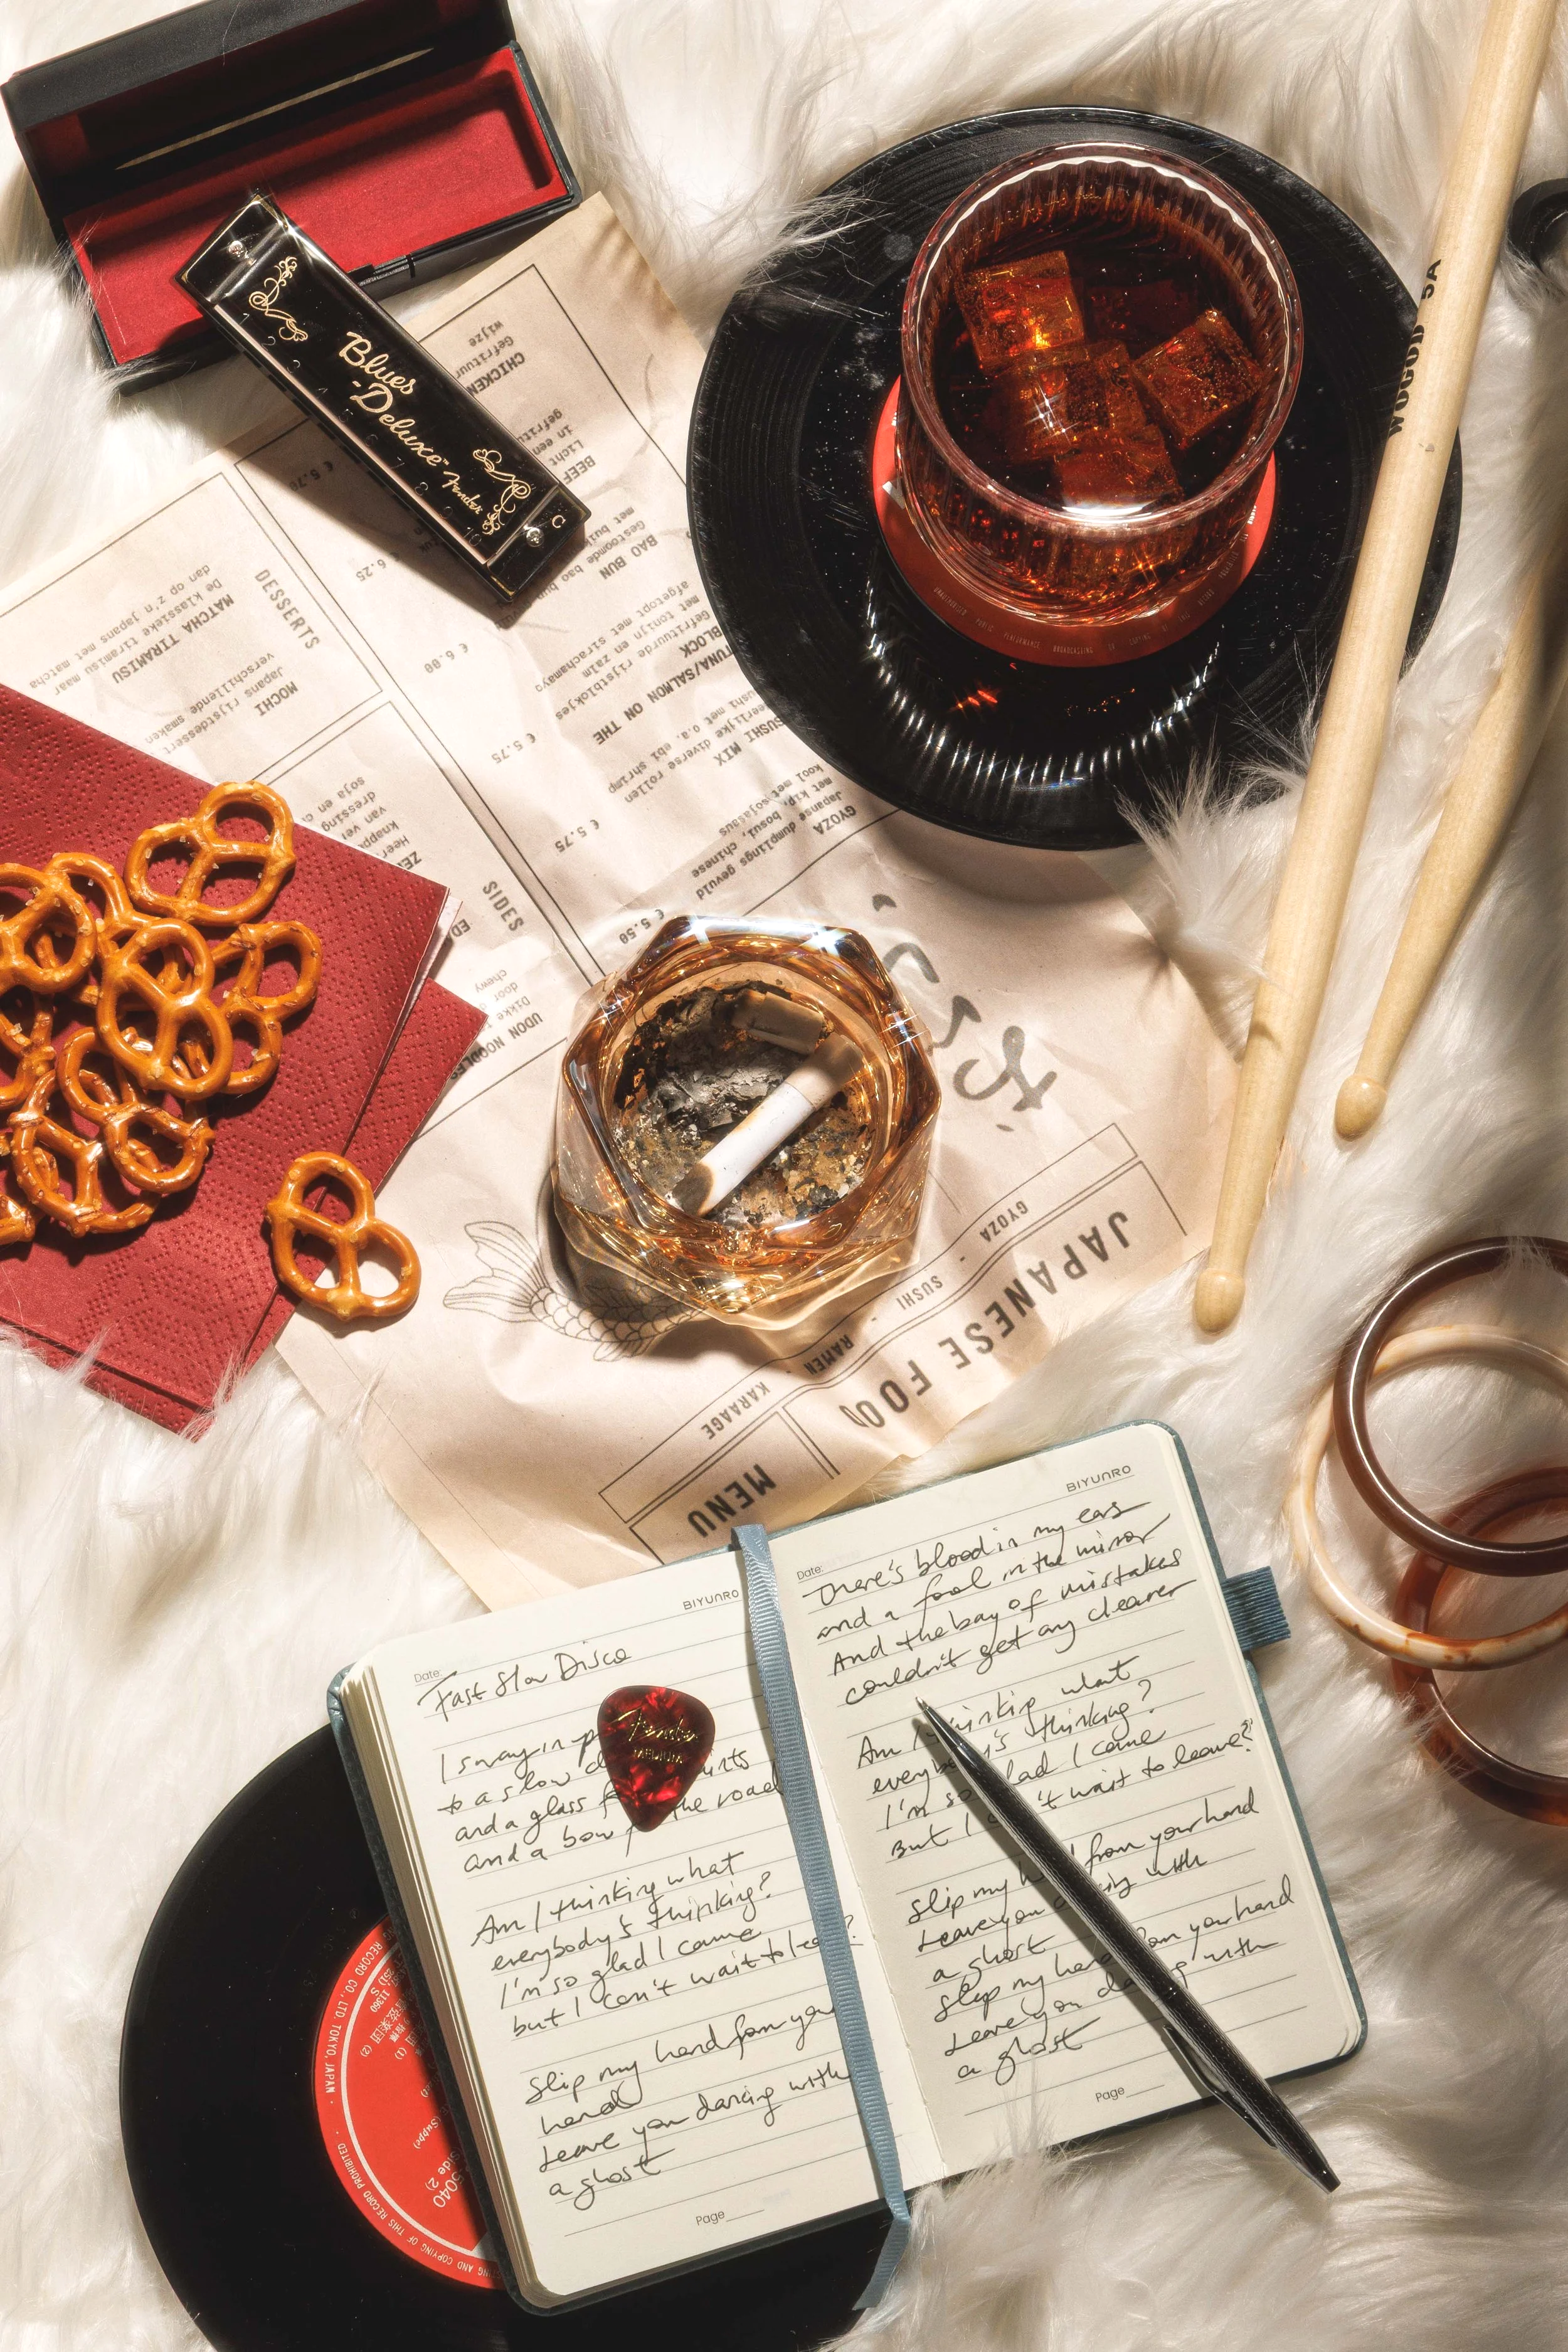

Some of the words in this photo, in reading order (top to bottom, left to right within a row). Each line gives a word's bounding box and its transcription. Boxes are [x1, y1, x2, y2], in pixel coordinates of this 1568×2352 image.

[1420, 258, 1442, 300] 5A
[467, 320, 503, 347] wijze
[341, 331, 416, 398] Blues
[465, 351, 524, 397] CHICKEN
[548, 438, 583, 466] Licht
[563, 455, 595, 484] BEEF
[551, 514, 566, 529] C
[585, 520, 645, 563] Gestoomde
[630, 534, 657, 557] BAO
[188, 564, 209, 582] dan
[355, 558, 386, 581] 6.25
[557, 564, 583, 581] bao
[598, 555, 627, 580] BUN
[204, 578, 222, 591] De
[635, 580, 688, 617] afgetopt
[141, 591, 203, 636] klassieke
[143, 595, 166, 613] z'n
[181, 593, 233, 633] MATCHA
[254, 569, 319, 649] DESSERTS
[99, 610, 139, 643] japans
[632, 610, 674, 640] tonijn
[637, 610, 710, 657] Gefrituurde
[83, 637, 138, 674] tiramisu
[677, 625, 722, 658] BLOCK
[28, 659, 70, 688] matcha
[111, 633, 179, 683] TIRAMISU
[423, 650, 454, 673] 6.00
[534, 637, 607, 692] sirachamayo
[581, 654, 610, 677] zalm
[54, 673, 80, 695] maar
[188, 652, 274, 714] verschillende
[243, 666, 282, 697] Japans
[554, 659, 632, 720] rijstblokjes
[646, 644, 733, 704] TUNA/SALMON
[253, 681, 298, 716] MOCHI
[623, 702, 643, 721] ON
[147, 714, 184, 743] smaken
[163, 697, 239, 753] rijstdessert
[592, 720, 621, 745] THE
[743, 715, 783, 744] SUSHI
[490, 739, 522, 763] 5.75
[649, 742, 671, 761] ebi
[667, 739, 710, 770] diverse
[712, 741, 741, 766] MIX
[336, 776, 364, 798] soja
[608, 761, 646, 793] shrimp
[623, 770, 663, 803] rollen
[795, 763, 824, 782] kool
[320, 791, 375, 832] dressing
[718, 793, 769, 837] sojasaus
[797, 790, 842, 822] Japanse
[812, 805, 857, 835] GYOZA
[554, 826, 586, 852] 5.75
[739, 820, 796, 866] dumplings
[691, 841, 737, 877] chinese
[695, 864, 735, 900] gevuld
[481, 880, 524, 931] SIDES
[618, 918, 651, 944] 5.50
[474, 969, 506, 992] chewy
[493, 982, 517, 1002] door
[495, 995, 530, 1020] Dikke
[507, 1012, 543, 1039] UDON
[978, 1200, 1028, 1242] GYOZA
[895, 1274, 943, 1310] SUSHI
[937, 1210, 1130, 1369] JAPANESE
[802, 1332, 854, 1380] RAMEN
[838, 1359, 931, 1428] FOOD
[692, 1381, 778, 1440] KARAAGE
[686, 1463, 777, 1539] MENU
[916, 1535, 988, 1577] blood
[797, 1566, 822, 1580] Date:
[817, 1607, 872, 1640] and
[834, 1636, 888, 1677] And
[1009, 1592, 1048, 1628] of
[1061, 1548, 1182, 1600] mistakes
[414, 1670, 440, 1683] Date:
[416, 1671, 487, 1722] Fast
[554, 1648, 632, 1682] Disco
[502, 1769, 571, 1803] slow
[455, 1813, 498, 1841] and
[526, 1797, 587, 1845] glass
[464, 1843, 519, 1872] and
[470, 1914, 525, 1947] Am
[667, 1851, 744, 1885] what
[354, 1942, 383, 1976] RECORD
[341, 1979, 358, 1998] CO.,
[370, 1989, 390, 2013] 11360
[513, 2008, 565, 2037] but
[691, 1951, 758, 1984] wait
[332, 2001, 349, 2020] LTD.
[324, 2025, 342, 2059] TOKYO,
[359, 2045, 373, 2057] (2)
[395, 2047, 407, 2060] (1)
[992, 2016, 1101, 2086] ghost
[325, 2062, 335, 2094] JAPAN
[1095, 2087, 1125, 2102] Page
[337, 2143, 366, 2189] PROHIBITED
[570, 2148, 675, 2211] ghost
[363, 2190, 388, 2220] RECORD
[696, 2211, 725, 2226] Page
[388, 2219, 405, 2237] THIS
[407, 2235, 418, 2245] OF
[420, 2243, 453, 2265] COPYING
[457, 2261, 474, 2273] AND
